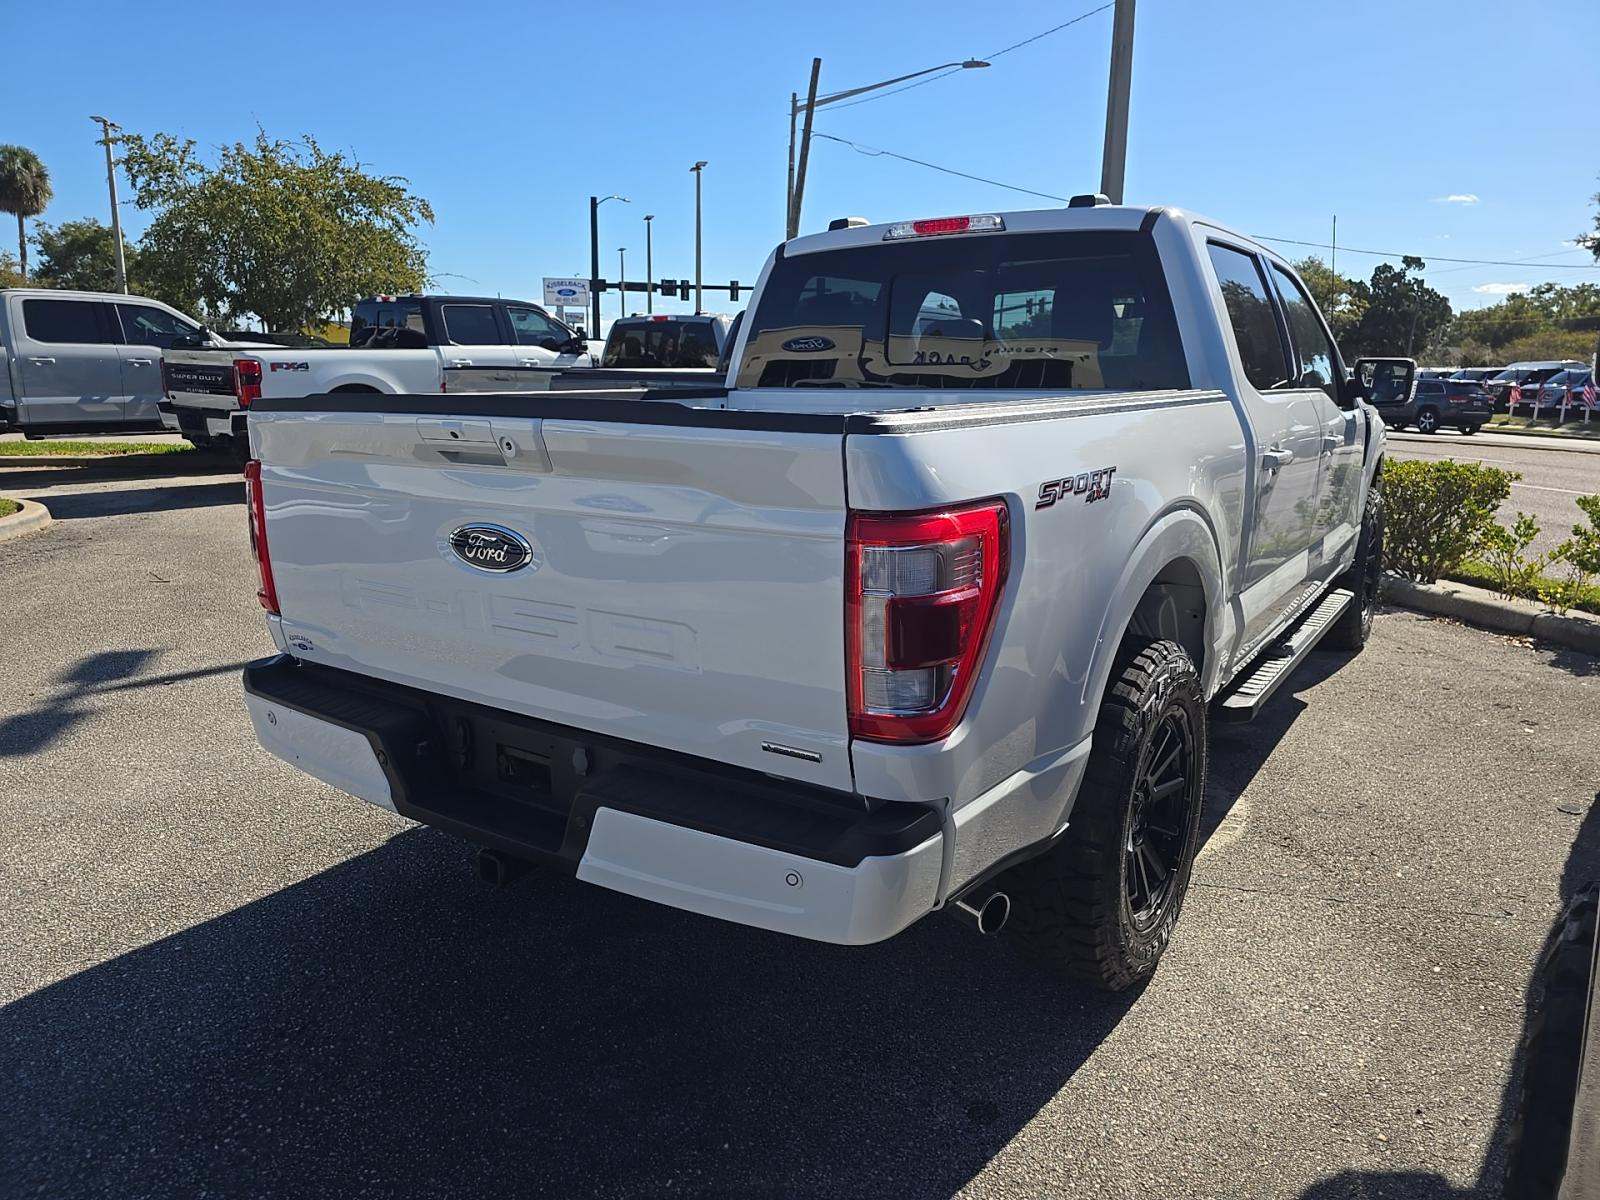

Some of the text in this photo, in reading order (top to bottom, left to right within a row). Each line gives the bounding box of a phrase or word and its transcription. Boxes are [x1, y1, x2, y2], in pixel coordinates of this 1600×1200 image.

[270, 362, 309, 372] FX4
[199, 374, 223, 382] DUTY
[1035, 466, 1116, 511] SPORT
[464, 532, 509, 562] Ford
